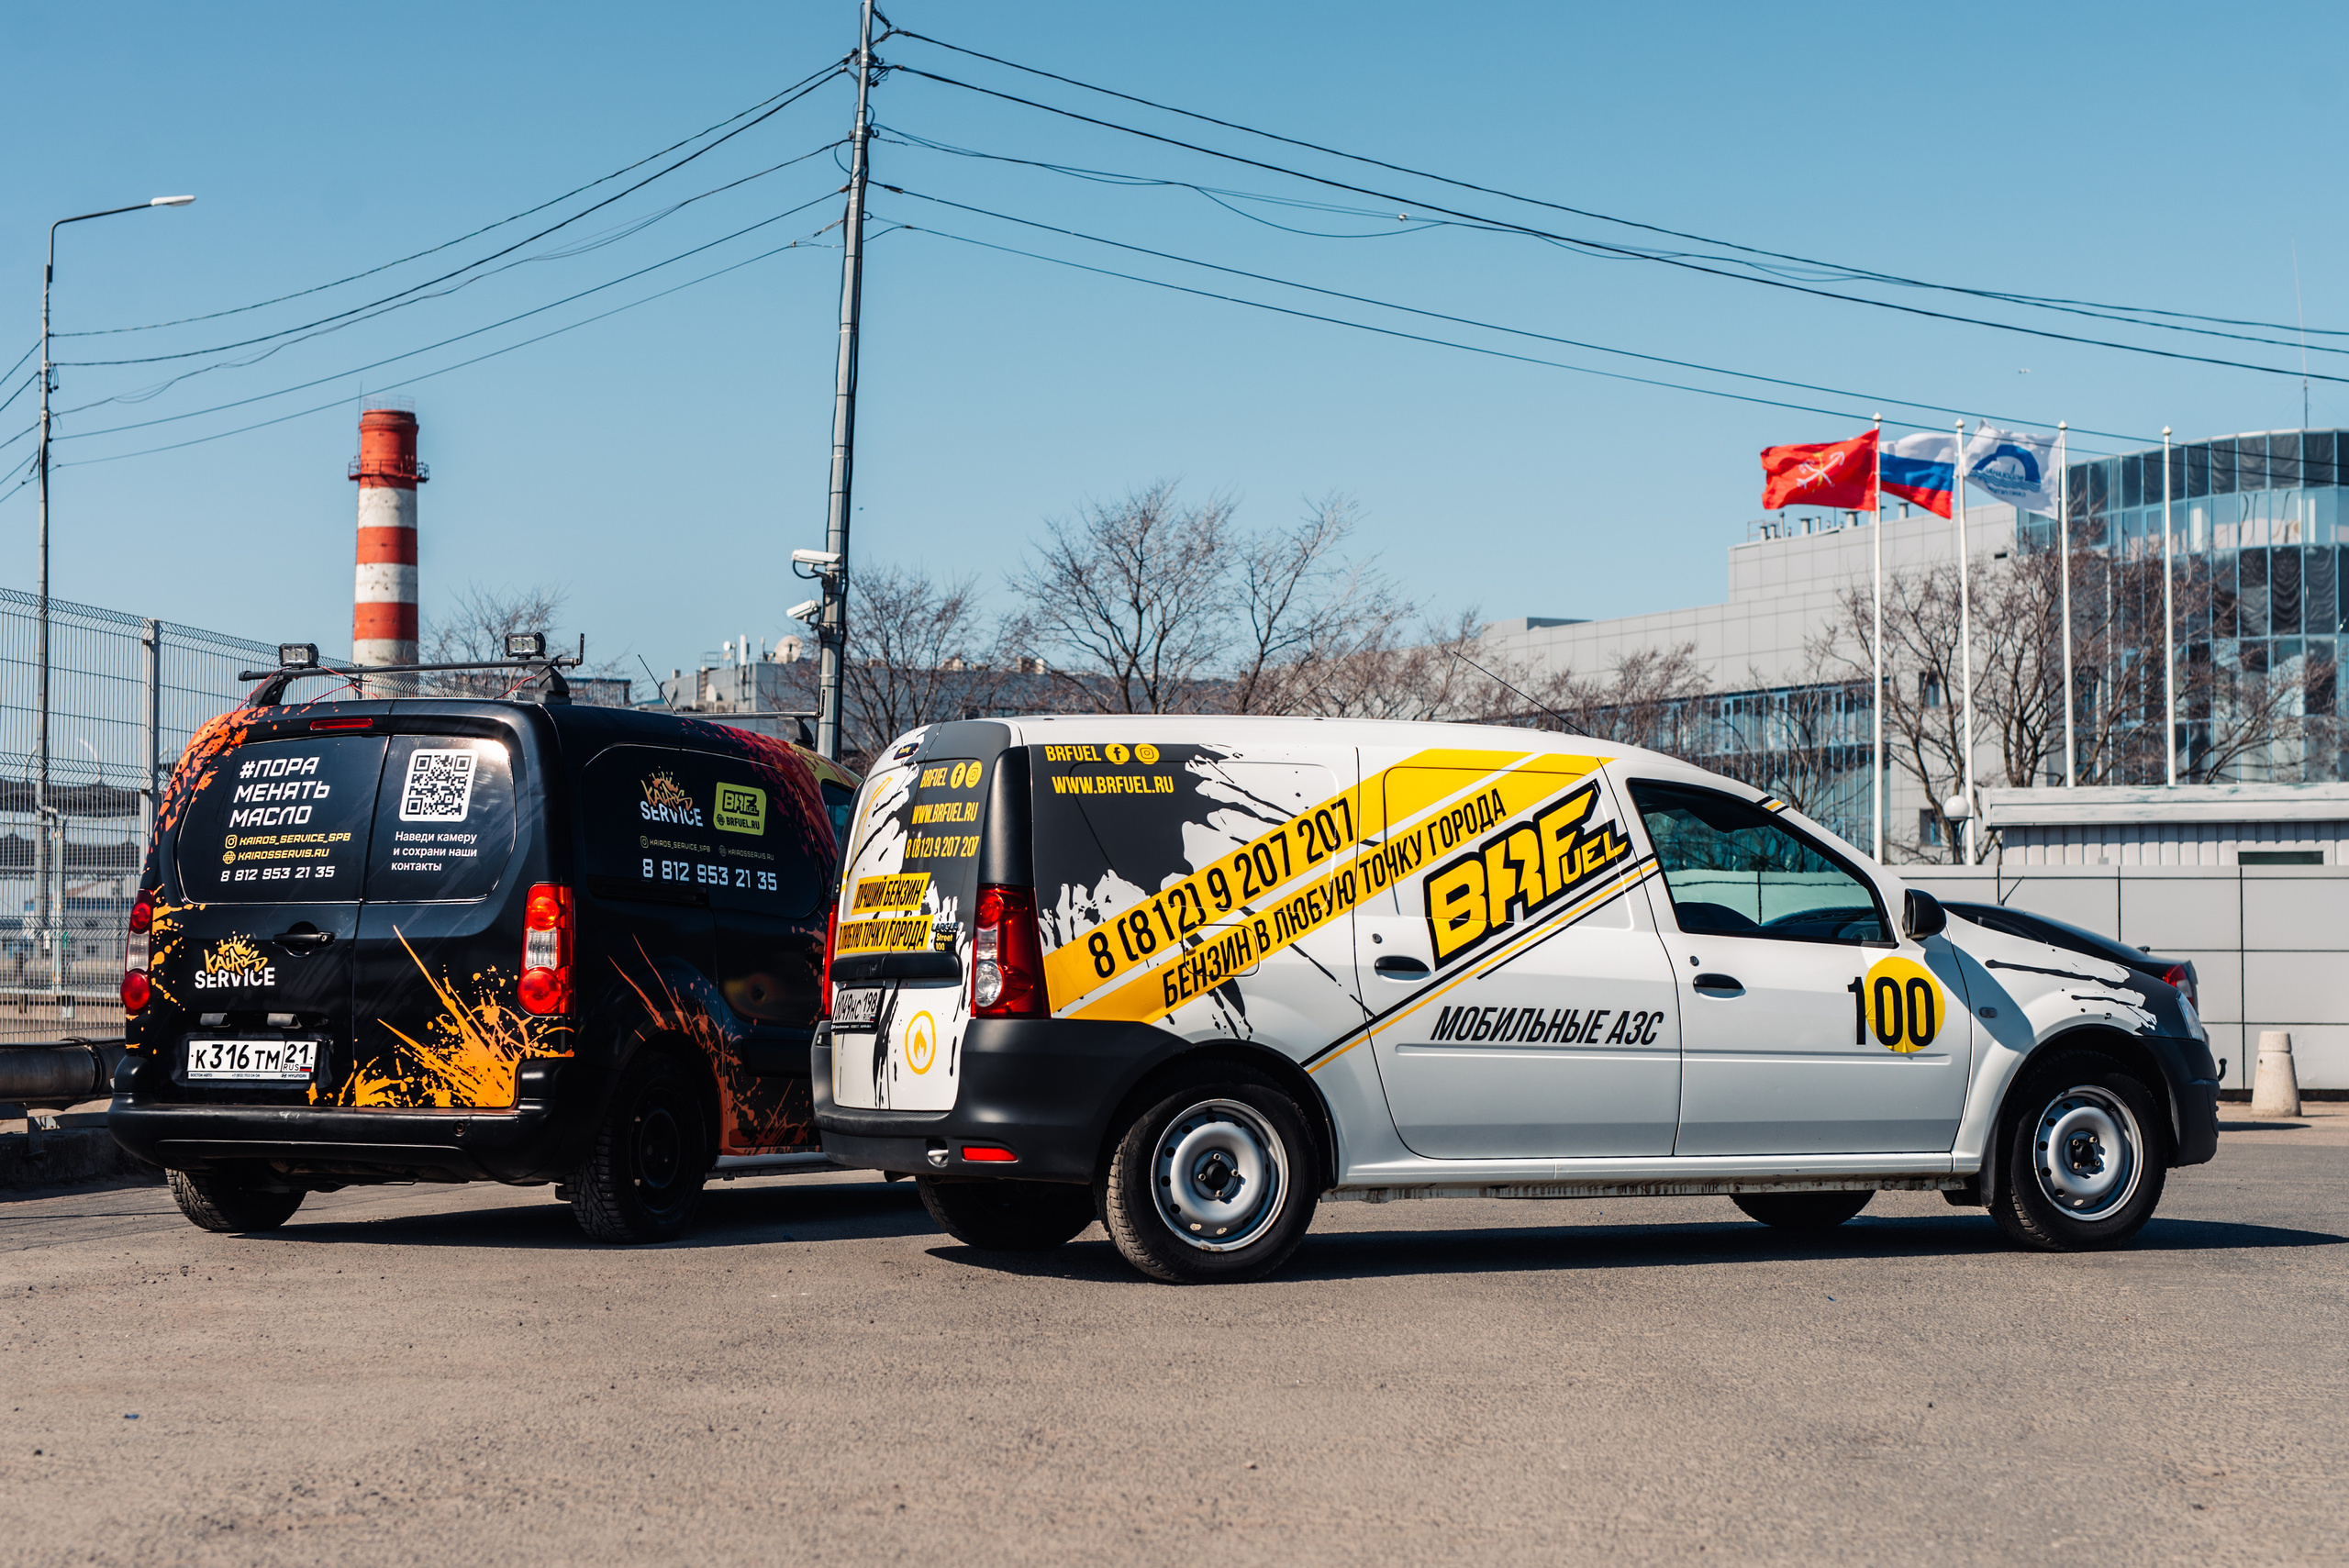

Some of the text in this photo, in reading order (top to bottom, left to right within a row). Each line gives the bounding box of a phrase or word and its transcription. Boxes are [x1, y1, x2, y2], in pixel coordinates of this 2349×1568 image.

[1044, 745, 1102, 762] BRFUEL
[239, 756, 320, 779] #ПОРА
[919, 767, 948, 788] BRFUEL
[233, 781, 331, 804] МЕНЯТЬ
[1052, 775, 1174, 795] WWW.BRFUEL.RU
[228, 806, 313, 828] МАСЛО
[640, 800, 703, 827] SERVICE
[726, 817, 761, 830] BRFUEL.RU
[911, 802, 979, 824] WWW.BRFUEL.RU
[239, 832, 351, 846] KAIROS_SERVICE_SPB
[395, 831, 478, 845] Наведи камеру
[649, 839, 711, 852] KAIROS_SERVICE_SPB
[905, 835, 980, 859] 8 (812) 9 207 207
[237, 848, 330, 862] KAIROSSERVIS.RU
[393, 847, 477, 859] и сохрани наши
[220, 865, 336, 883] 8 812 953 21 35
[391, 862, 442, 872] контакты
[642, 858, 777, 891] 8 812 953 21 35
[853, 875, 925, 910] ЛУЧШИЙ БЕНЗИН
[1087, 796, 1355, 979] 8 (812) 9 207 207
[1162, 787, 1508, 1009] БЕНЗИН В ЛЮБУЮ ТОЧКУ ГОРОДА
[861, 920, 886, 948] ТОЧКУ
[885, 919, 928, 950] ГОРОДА
[931, 921, 960, 932] LARGUS
[936, 932, 953, 941] Street
[935, 942, 945, 951] 100
[195, 966, 275, 990] SERVICE
[1847, 976, 1936, 1047] 100
[1430, 1006, 1664, 1046] МОБИЛЬНЫЕ АЗС
[284, 1043, 309, 1064] 21
